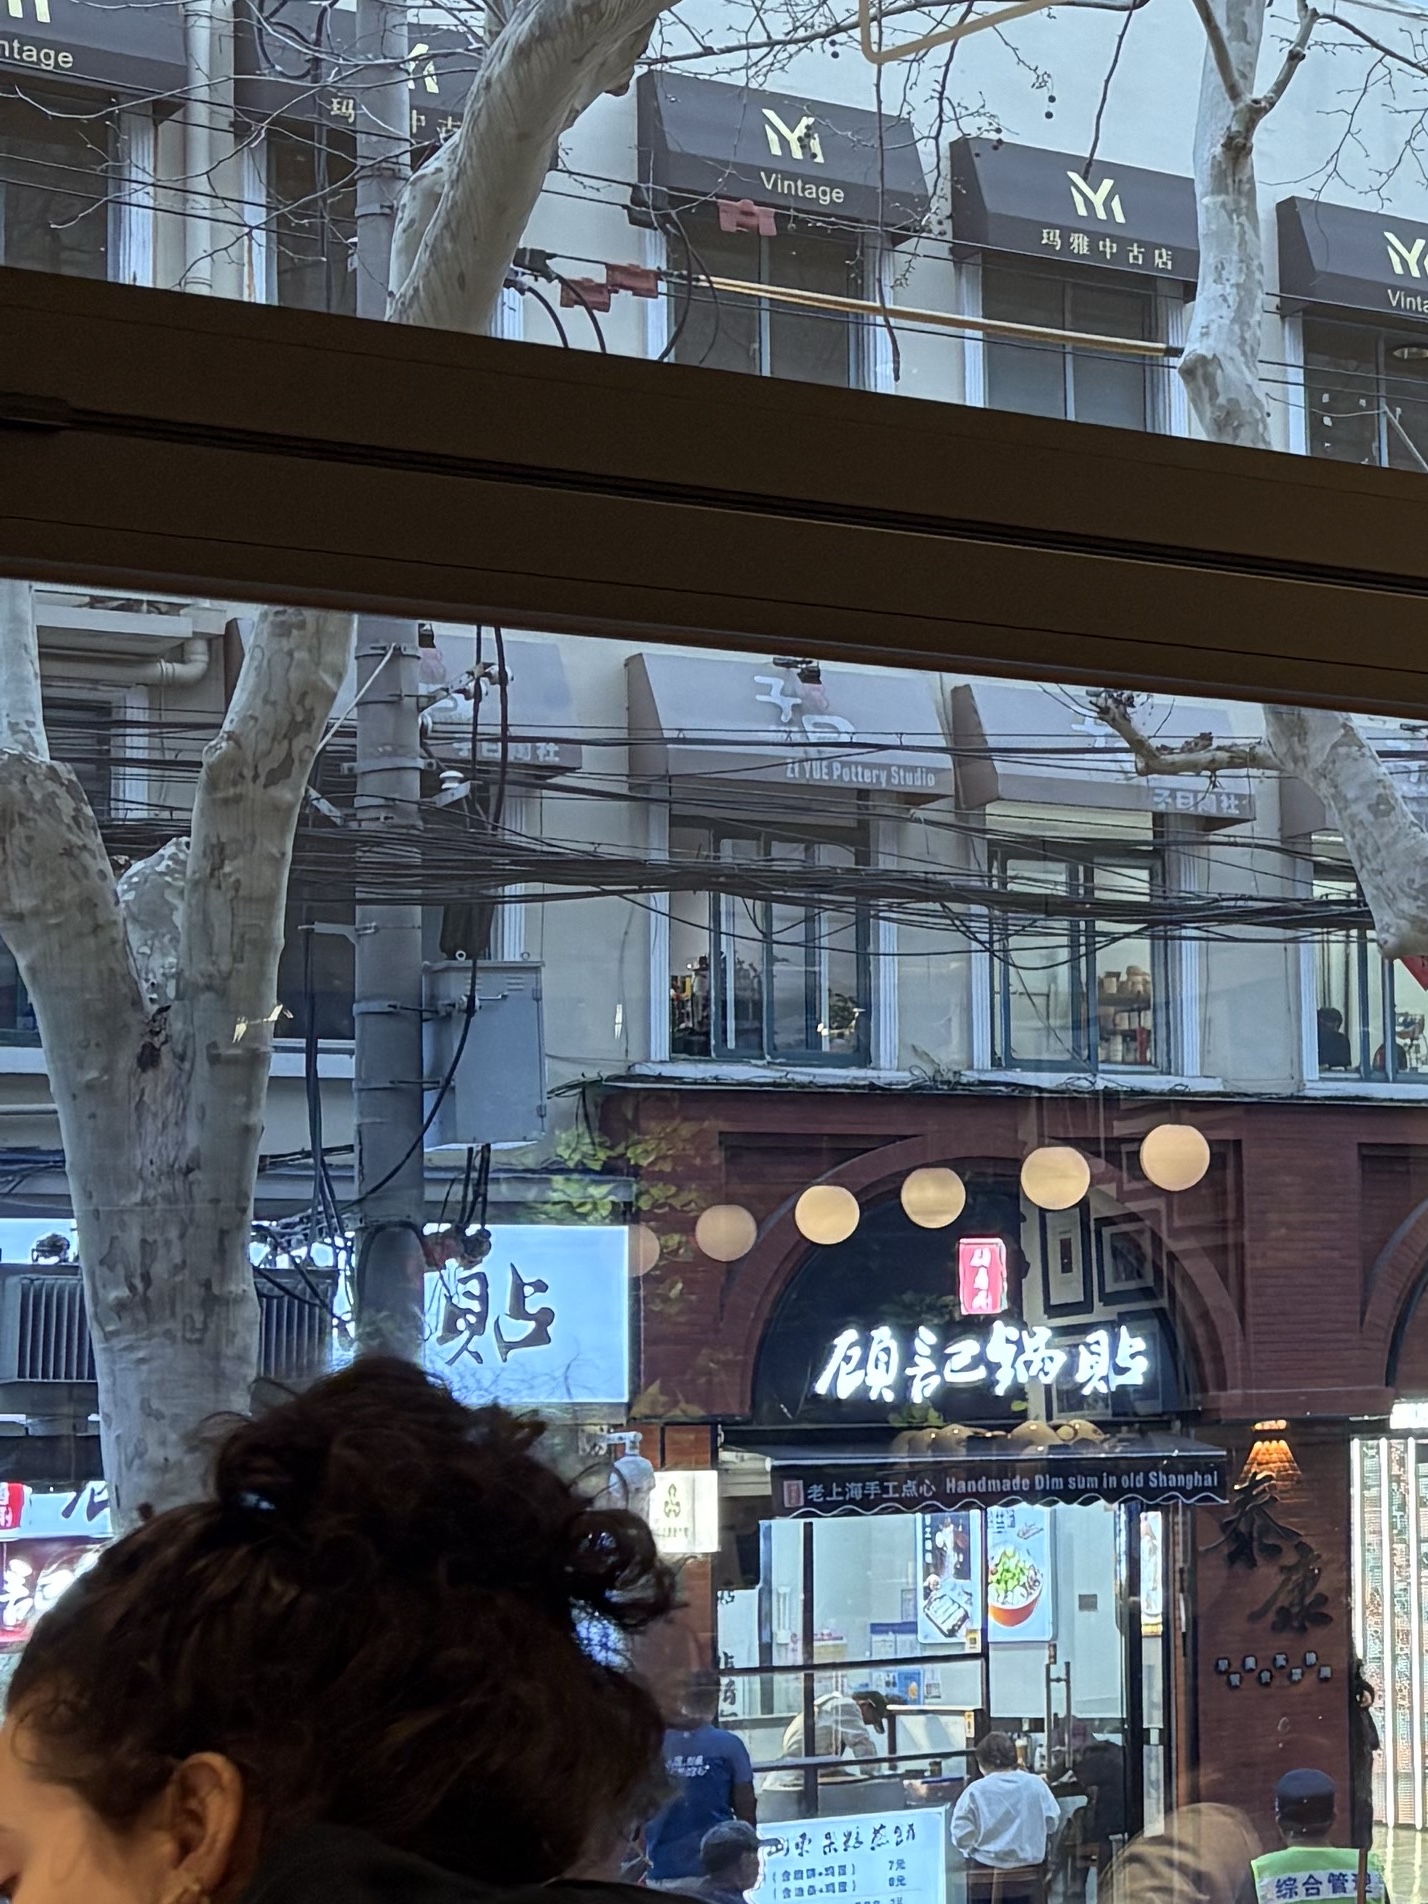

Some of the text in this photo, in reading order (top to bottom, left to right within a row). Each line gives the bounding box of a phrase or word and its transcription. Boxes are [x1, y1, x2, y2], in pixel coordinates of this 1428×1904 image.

[760, 171, 845, 206] Vintage
[1040, 228, 1173, 272] 玛雅中古店
[802, 759, 830, 781] YUE
[832, 760, 887, 789] Pottery
[890, 765, 936, 788] Studio
[807, 1479, 936, 1502] 老上海手工点心
[945, 1470, 1219, 1495] Handmade Dim sum in old Shanghai
[1274, 1871, 1374, 1900] 综合管理
